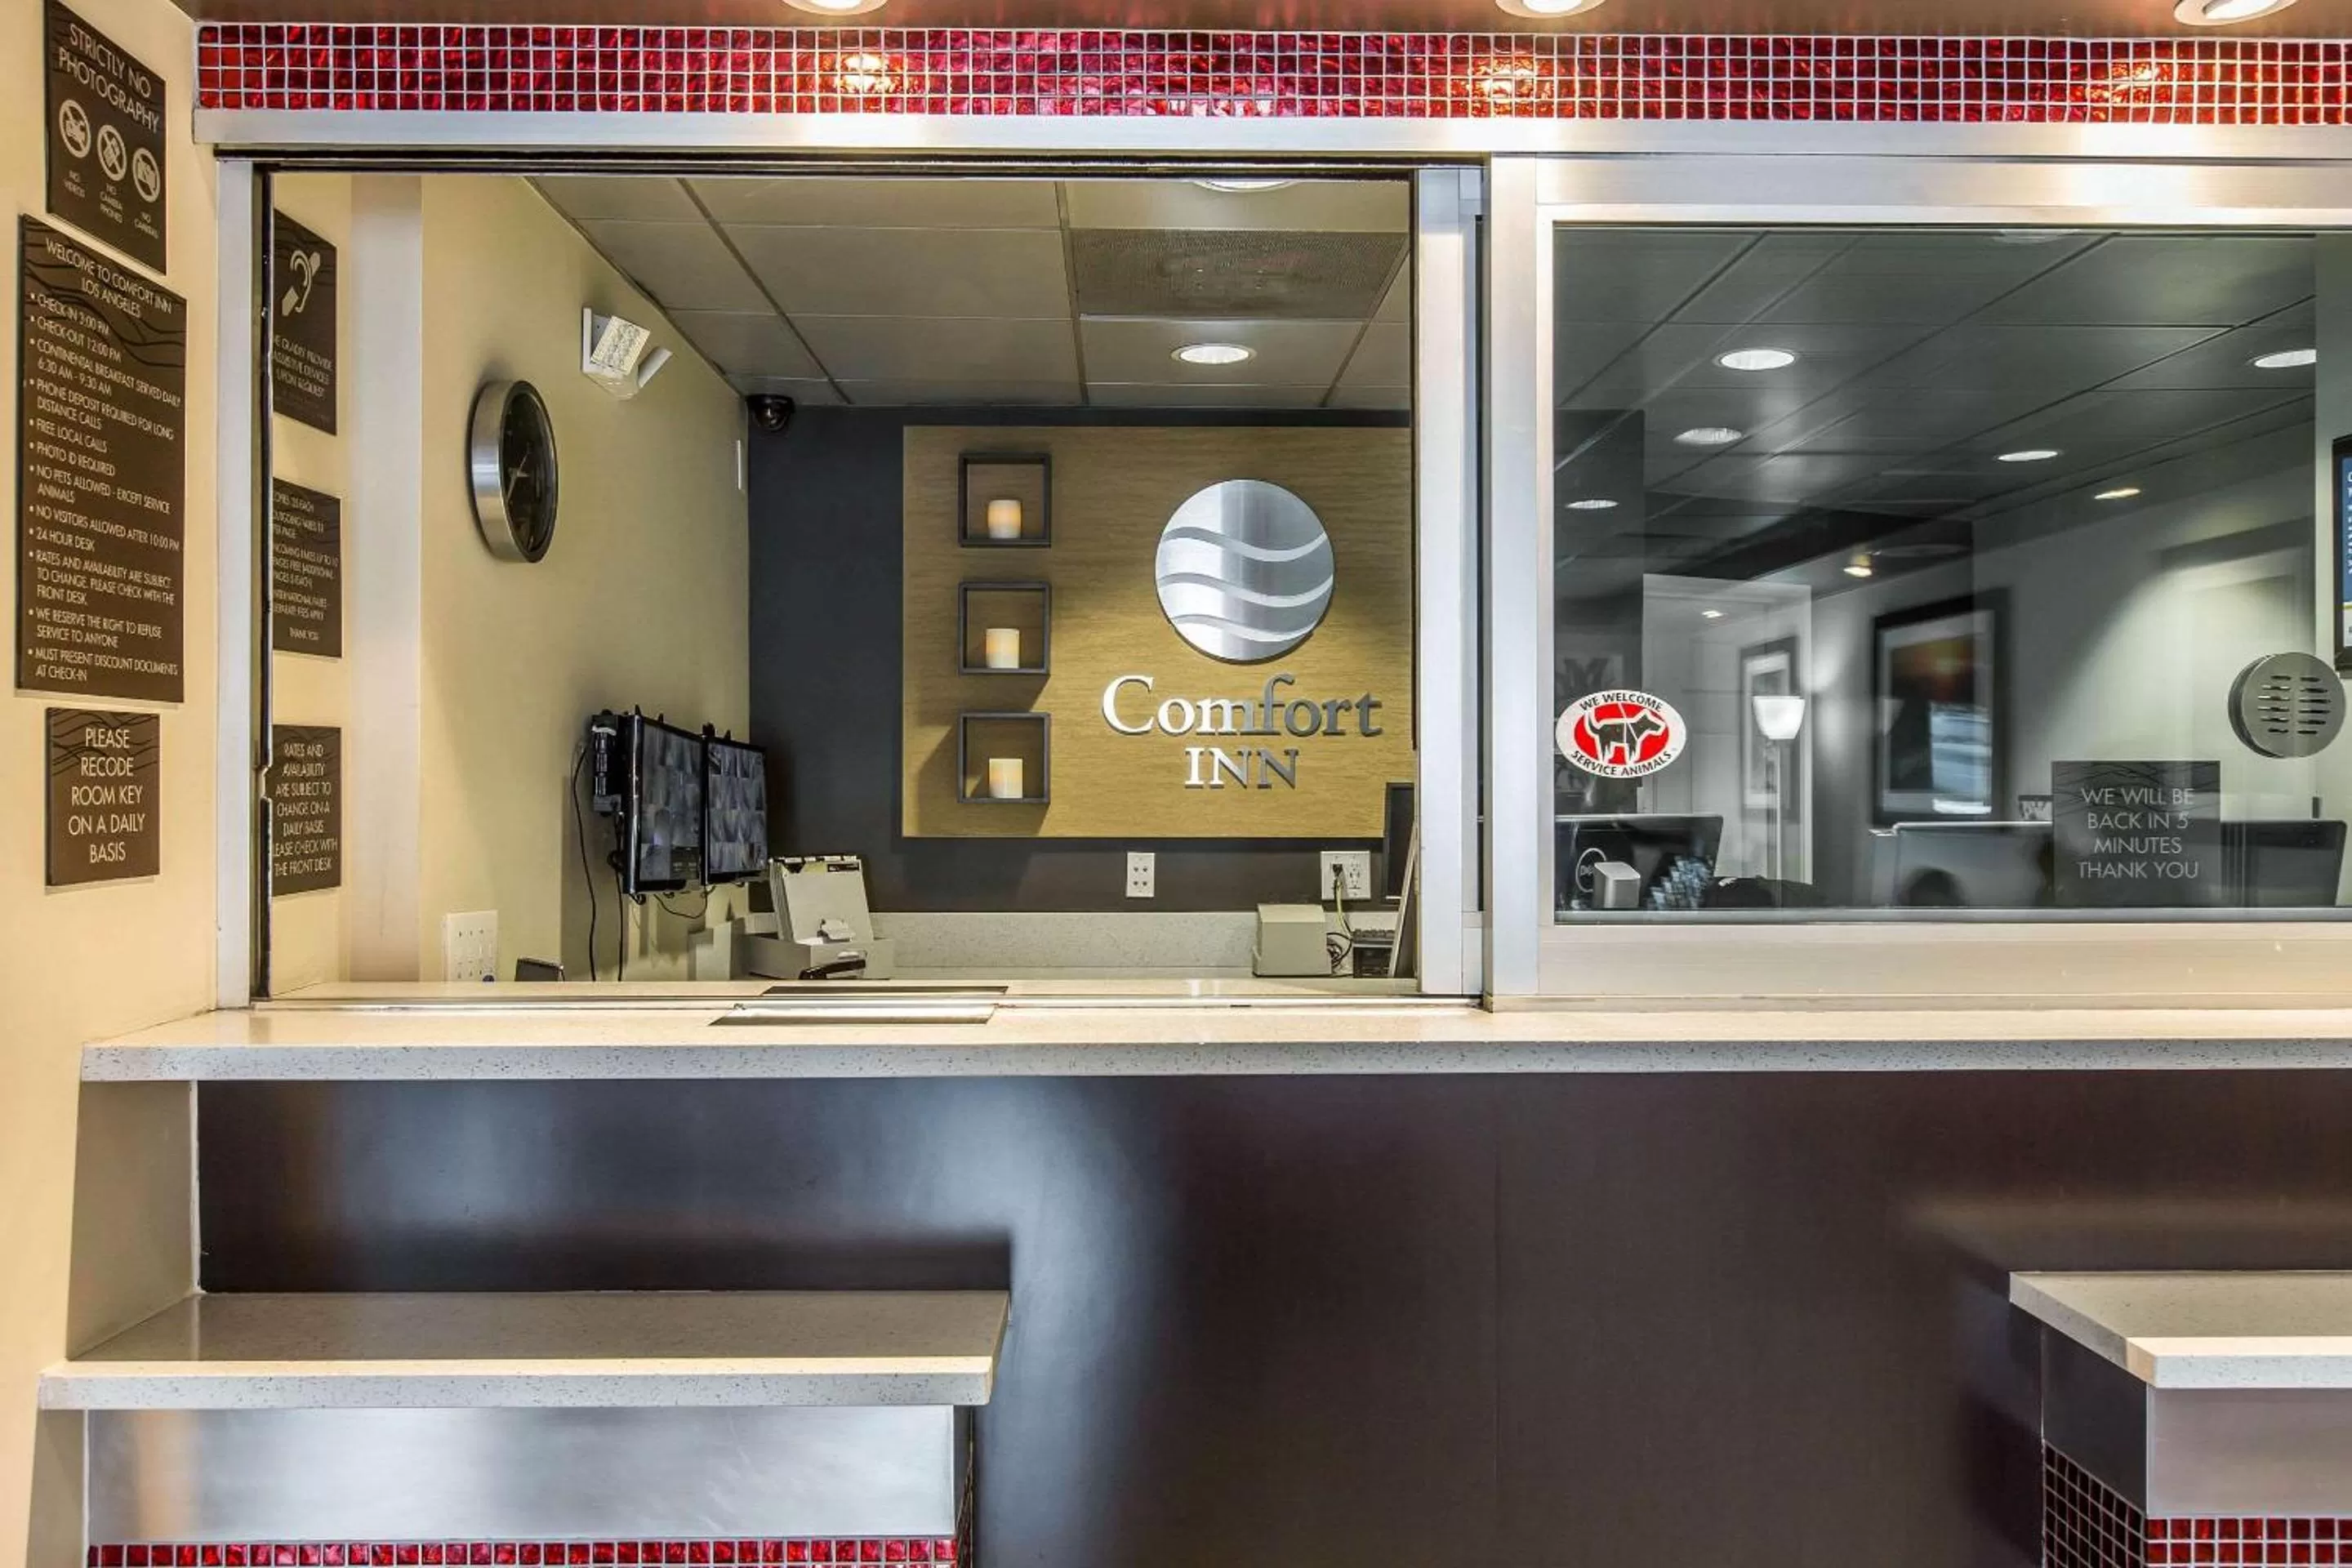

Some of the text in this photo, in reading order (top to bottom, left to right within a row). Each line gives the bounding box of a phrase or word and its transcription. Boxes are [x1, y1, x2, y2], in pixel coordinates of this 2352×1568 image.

[70, 23, 151, 98] STRICTLY NO
[59, 47, 159, 134] PHOTOGRAPHY
[47, 237, 172, 314] WELCOME TO COMFORT INN
[82, 277, 141, 318] LOS ANGELES
[98, 320, 109, 335] PM
[87, 336, 108, 357] 12:00
[109, 348, 122, 363] PM
[38, 339, 93, 372] CONTINENTAL
[95, 362, 135, 389] BREAKFAST
[38, 357, 57, 374] 6:30
[58, 365, 73, 381] AM
[98, 381, 112, 396] AM
[37, 378, 66, 400] PHONE
[68, 390, 100, 412] DEPOSIT
[101, 403, 136, 425] REQUIRED
[138, 416, 152, 433] FOR
[38, 395, 102, 430] DISTANCE CALLS
[37, 417, 107, 453] FREE LOCAL CALLS
[37, 441, 115, 476] PHOTO ID REQUIRED
[37, 464, 52, 479] NO
[53, 468, 72, 485] PETS
[74, 475, 111, 497] ALLOWED
[117, 488, 142, 506] EXCEPT
[144, 494, 171, 514] SERVICE
[38, 483, 75, 503] ANIMALS
[36, 505, 52, 520] NO
[53, 509, 88, 529] VISITORS
[89, 519, 126, 537] ALLOWED
[127, 528, 147, 544] AFTER
[169, 538, 180, 551] PM
[37, 526, 95, 552] 24 HOUR DESK
[36, 550, 172, 589] RATES AND AVAILABILITY ARE SUBJECT
[37, 567, 49, 581] TO
[90, 578, 115, 594] PLEASE
[118, 583, 142, 599] CHECK
[163, 592, 175, 605] THE
[37, 584, 65, 601] FRONT
[36, 607, 163, 639] WE RESERVE THE RIGHT TO REFUSE
[37, 625, 118, 648] SERVICE TO ANYONE
[35, 647, 178, 676] MUST PRESENT DISCOUNT DOCUMENTS
[35, 665, 47, 677] AT
[1102, 673, 1383, 737] Comfort
[1579, 693, 1664, 712] WE WELCOME
[86, 728, 130, 749] PLEASE
[81, 757, 135, 777] RECODE
[1185, 747, 1299, 790] INN
[1570, 750, 1672, 776] SERVICE ANIMALS
[71, 785, 143, 806] ROOM KEY
[2081, 786, 2195, 805] WE WILL BE
[69, 813, 146, 835] ON A DAILY
[2087, 811, 2189, 830] BACK IN 5
[90, 841, 127, 863] BASIS
[2094, 836, 2182, 854] MINUTES
[2077, 862, 2198, 879] THANK YOU
